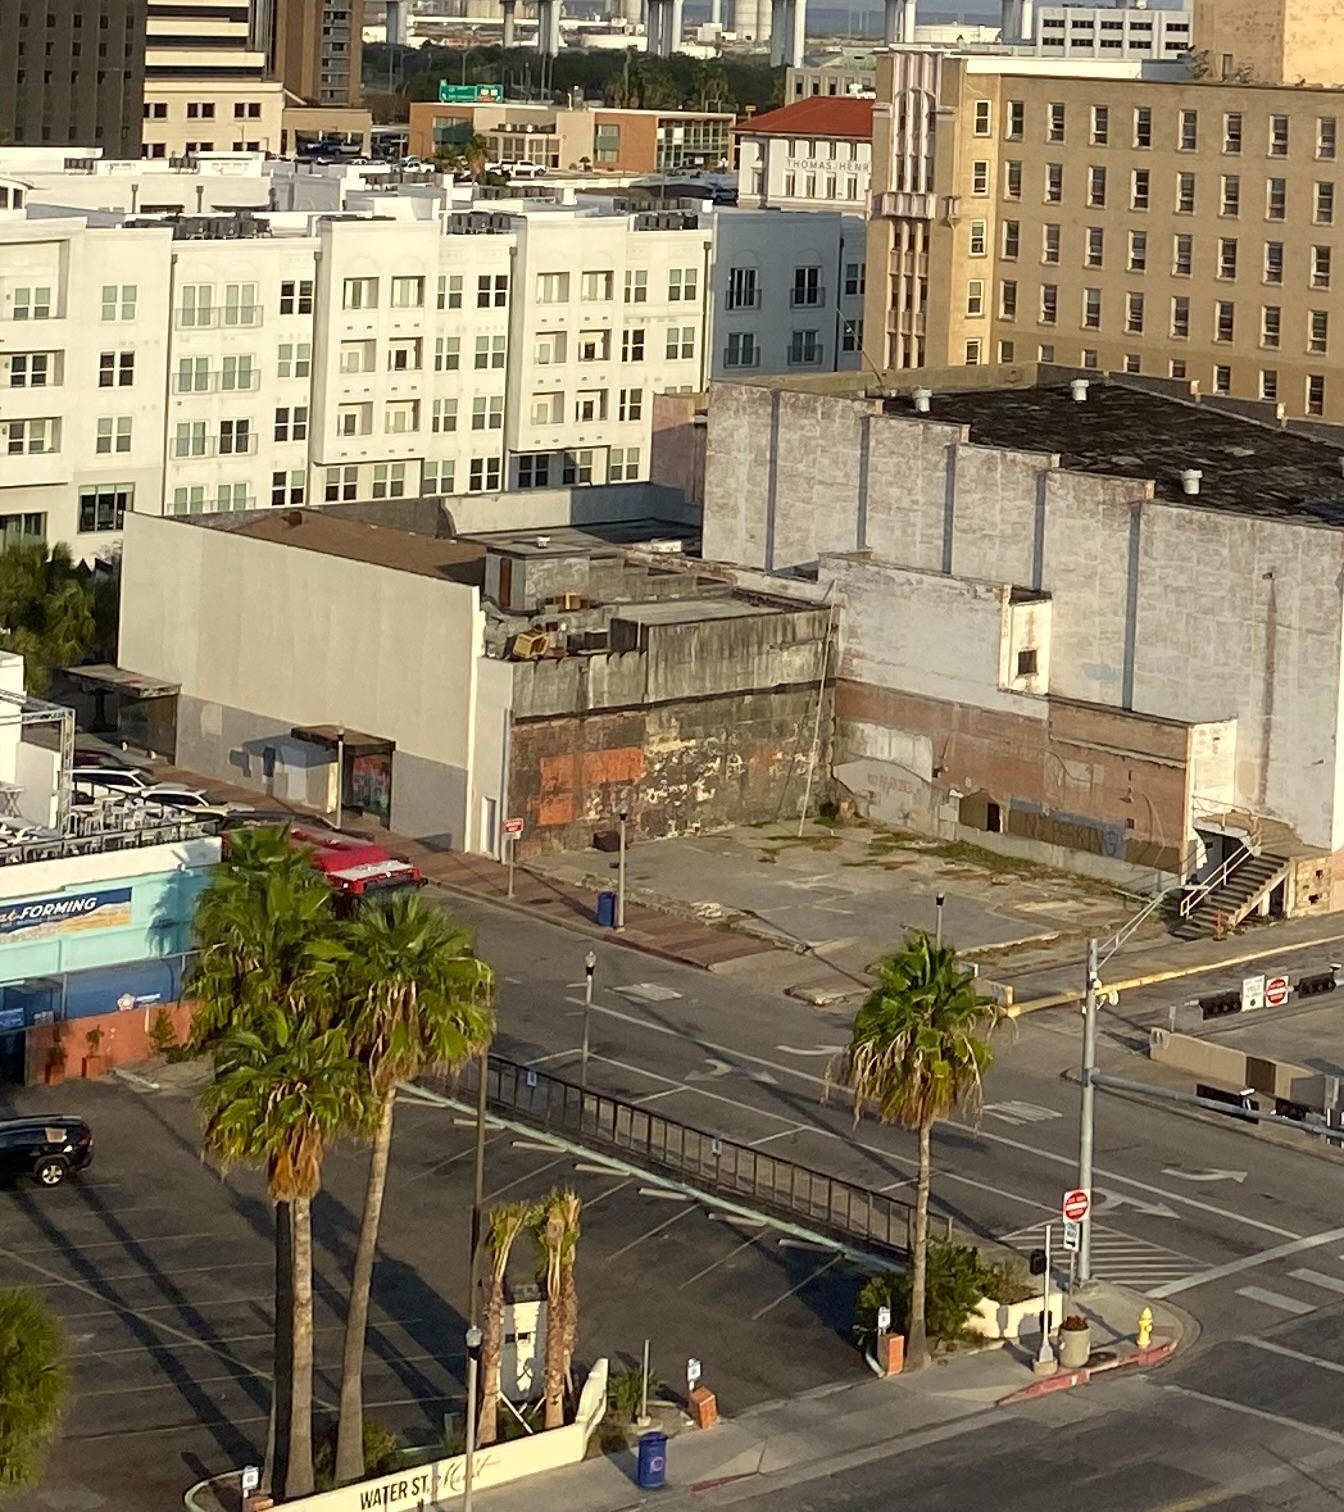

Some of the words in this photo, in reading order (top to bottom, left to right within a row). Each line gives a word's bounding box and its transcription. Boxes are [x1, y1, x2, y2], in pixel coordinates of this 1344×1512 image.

[786, 158, 832, 170] THOMAS
[839, 161, 869, 172] HENR
[360, 1480, 408, 1510] WATER
[411, 1474, 430, 1497] ST.
